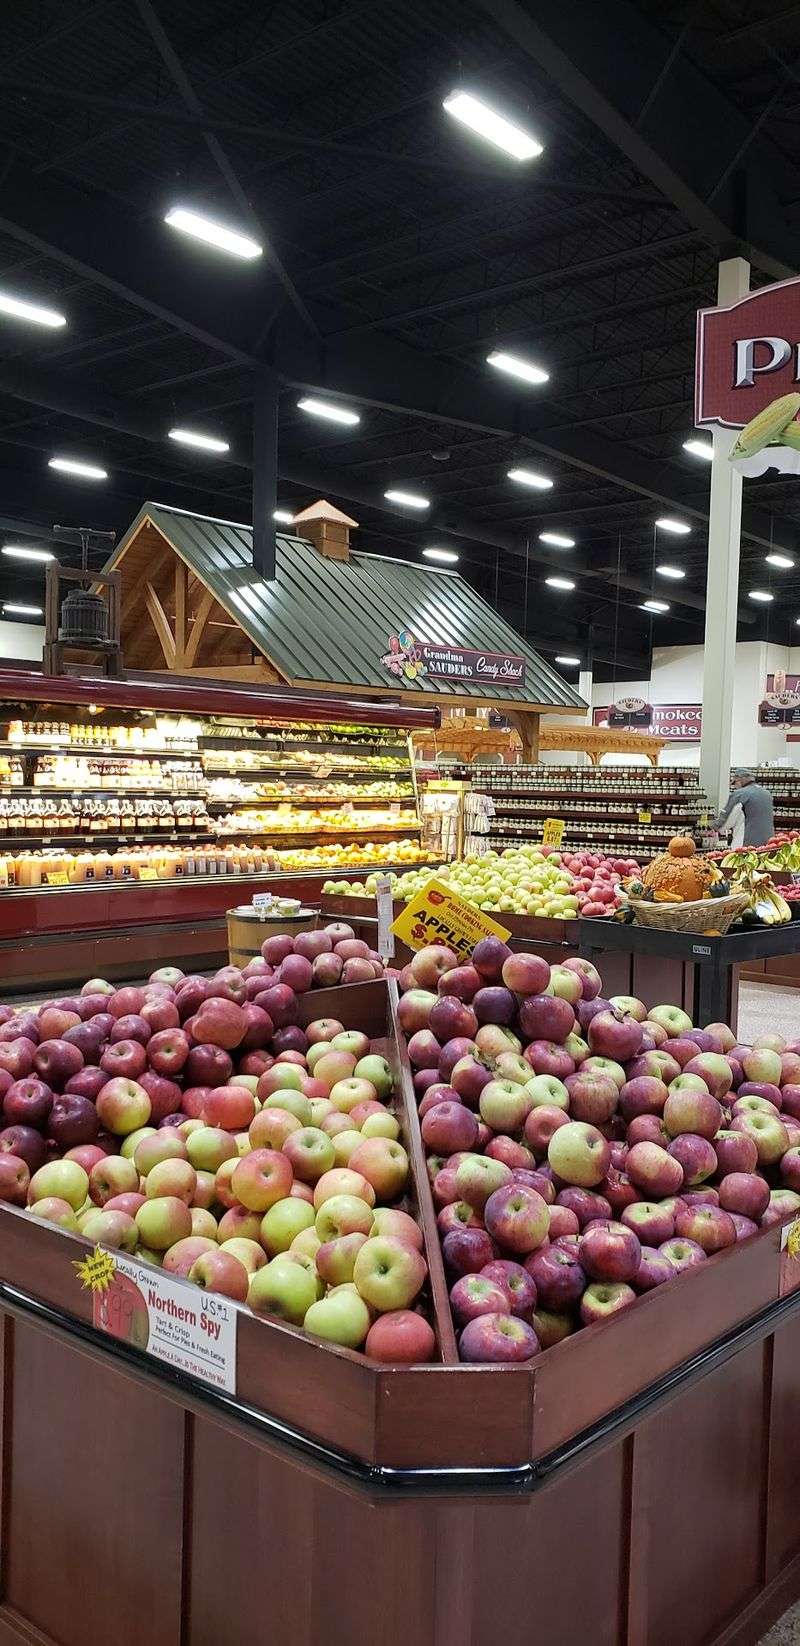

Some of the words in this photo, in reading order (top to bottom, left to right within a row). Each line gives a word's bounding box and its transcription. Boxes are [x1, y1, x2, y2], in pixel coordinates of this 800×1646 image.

[423, 647, 464, 662] Grandma
[429, 660, 473, 677] SAUDERS
[476, 656, 499, 679] Candy
[499, 659, 523, 678] Shack
[653, 709, 703, 721] moke
[648, 724, 700, 736] Meats
[88, 1259, 106, 1271] NEW
[90, 1269, 109, 1282] CROP
[148, 1289, 196, 1327] Northern
[200, 1312, 221, 1341] Spy
[156, 1315, 167, 1327] Tart
[168, 1321, 173, 1330] &
[174, 1325, 190, 1338] Crisp
[196, 1343, 209, 1355] Fresh
